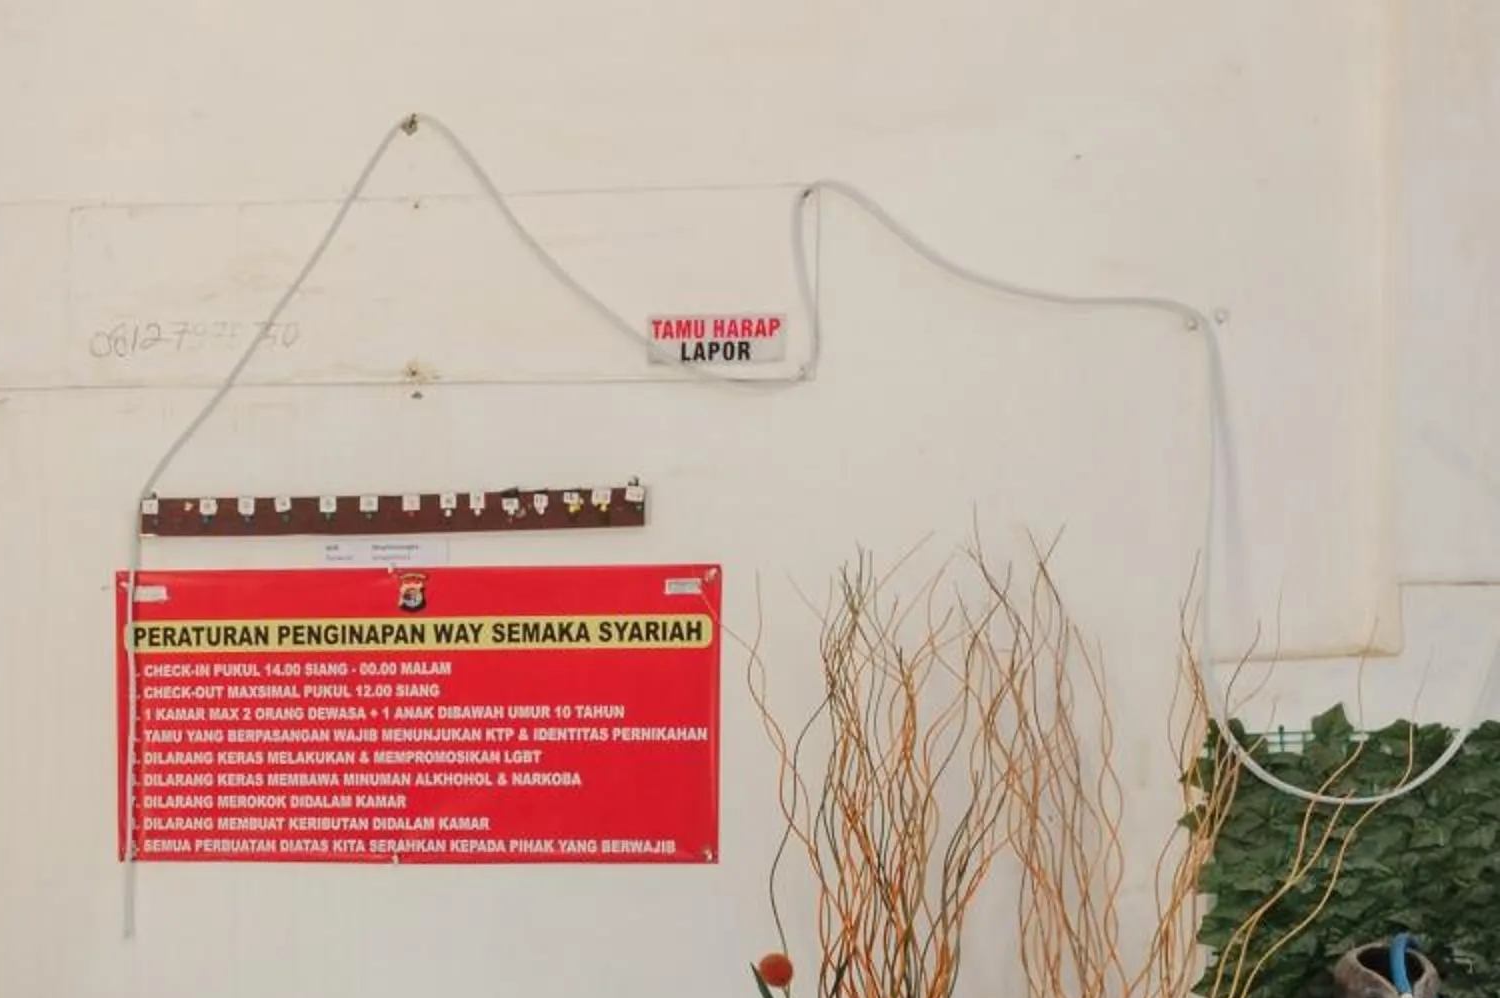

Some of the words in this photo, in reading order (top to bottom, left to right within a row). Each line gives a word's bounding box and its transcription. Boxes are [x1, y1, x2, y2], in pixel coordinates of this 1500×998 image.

[652, 319, 705, 339] TAMU
[713, 318, 781, 338] HARAP
[681, 341, 751, 361] LAPOR
[133, 625, 269, 647] PERATURAN
[277, 623, 425, 646] PENGINAPAN
[434, 623, 483, 644] WAY
[492, 622, 590, 643] SEMAKA
[598, 620, 702, 642] SYARIAH
[144, 664, 211, 677] CHECK-IN
[213, 663, 260, 676] PUKUL
[265, 663, 300, 676] 14.00
[304, 662, 347, 675] SIANG
[359, 662, 397, 675] 00.00
[401, 661, 452, 674] MALAM
[144, 686, 224, 699] CHECK-OUT
[227, 685, 300, 698] MAXSIMAL
[303, 684, 351, 697] PUKUL
[355, 684, 392, 697] 12.00
[396, 684, 440, 697] SIANG
[144, 708, 152, 721] 1
[155, 708, 205, 721] KAMAR
[209, 707, 239, 720] MAX
[242, 707, 252, 720] 2
[255, 707, 304, 720] ORANG
[307, 707, 366, 720] DEWASA
[382, 706, 389, 719] 1
[393, 706, 433, 719] ANAK
[437, 706, 504, 719] DIBAWAH
[508, 705, 551, 718] UMUR
[555, 705, 571, 718] 10
[576, 705, 625, 718] TAHUN
[144, 730, 182, 743] TAMU
[186, 730, 224, 743] YANG
[227, 729, 330, 742] BERPASANGAN
[333, 729, 378, 742] WAJIB
[381, 728, 481, 741] MENUNJUKAN
[485, 728, 515, 741] KTP
[518, 728, 528, 741] &
[533, 728, 608, 741] IDENTITAS
[612, 727, 708, 740] PERNIKAHAN
[144, 752, 213, 765] DILARANG
[217, 752, 264, 765] KERAS
[267, 751, 355, 764] MELAKUKAN
[359, 751, 369, 764] &
[373, 750, 500, 763] MEMPROMOSIKAN
[504, 750, 542, 763] LGBT
[144, 774, 213, 787] DILARANG
[217, 774, 264, 787] KERAS
[267, 773, 339, 786] MEMBAWA
[343, 773, 410, 786] MINUMAN
[415, 773, 493, 786] ALKHOHOL
[497, 773, 507, 786] &
[512, 773, 581, 786] NARKOBA
[144, 796, 213, 809] DILARANG
[217, 796, 287, 809] MEROKOK
[290, 796, 352, 809] DIDALAM
[355, 796, 406, 809] KAMAR
[144, 817, 213, 830] DILARANG
[217, 817, 284, 830] MEMBUAT
[288, 817, 368, 830] KERIBUTAN
[372, 817, 434, 830] DIDALAM
[438, 817, 490, 830] KAMAR
[144, 839, 191, 852] SEMUA
[195, 839, 276, 852] PERBUATAN
[279, 839, 329, 852] DIATAS
[333, 839, 367, 852] KITA
[370, 839, 446, 852] SERAHKAN
[450, 839, 507, 852] KEPADA
[510, 839, 554, 852] PIHAK
[558, 839, 597, 852] YANG
[601, 839, 676, 852] BERWAJIB
